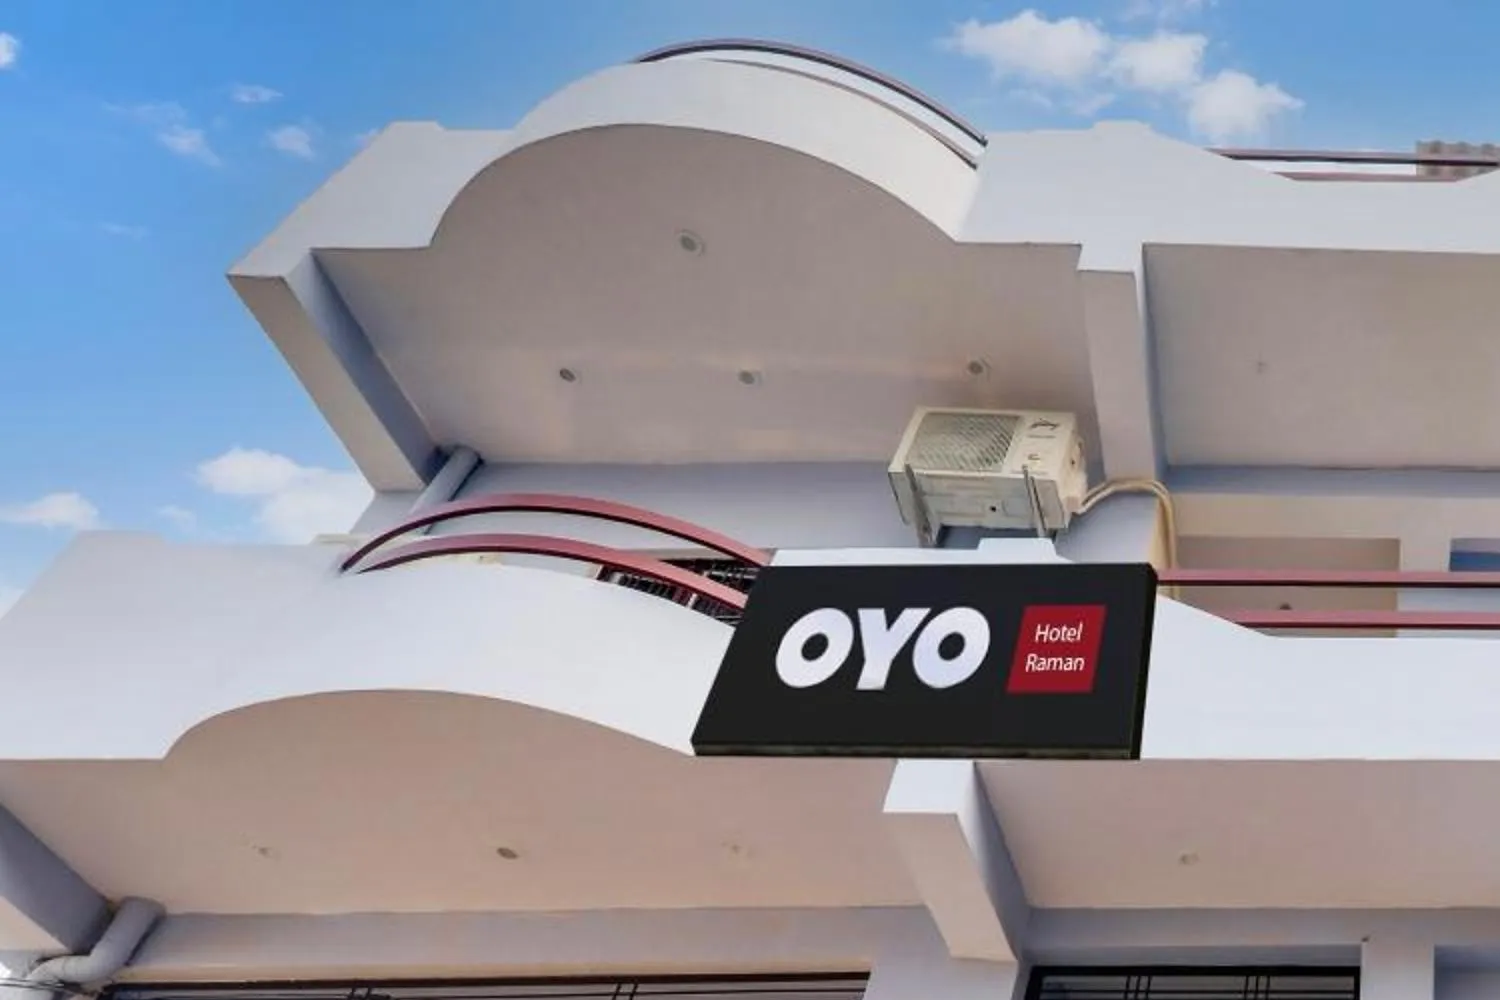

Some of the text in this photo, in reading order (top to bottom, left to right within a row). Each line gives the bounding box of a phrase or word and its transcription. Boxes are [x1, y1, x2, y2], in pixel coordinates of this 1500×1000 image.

[1035, 621, 1083, 643] Hotel
[775, 606, 991, 690] OYO
[1025, 653, 1085, 672] Raman
